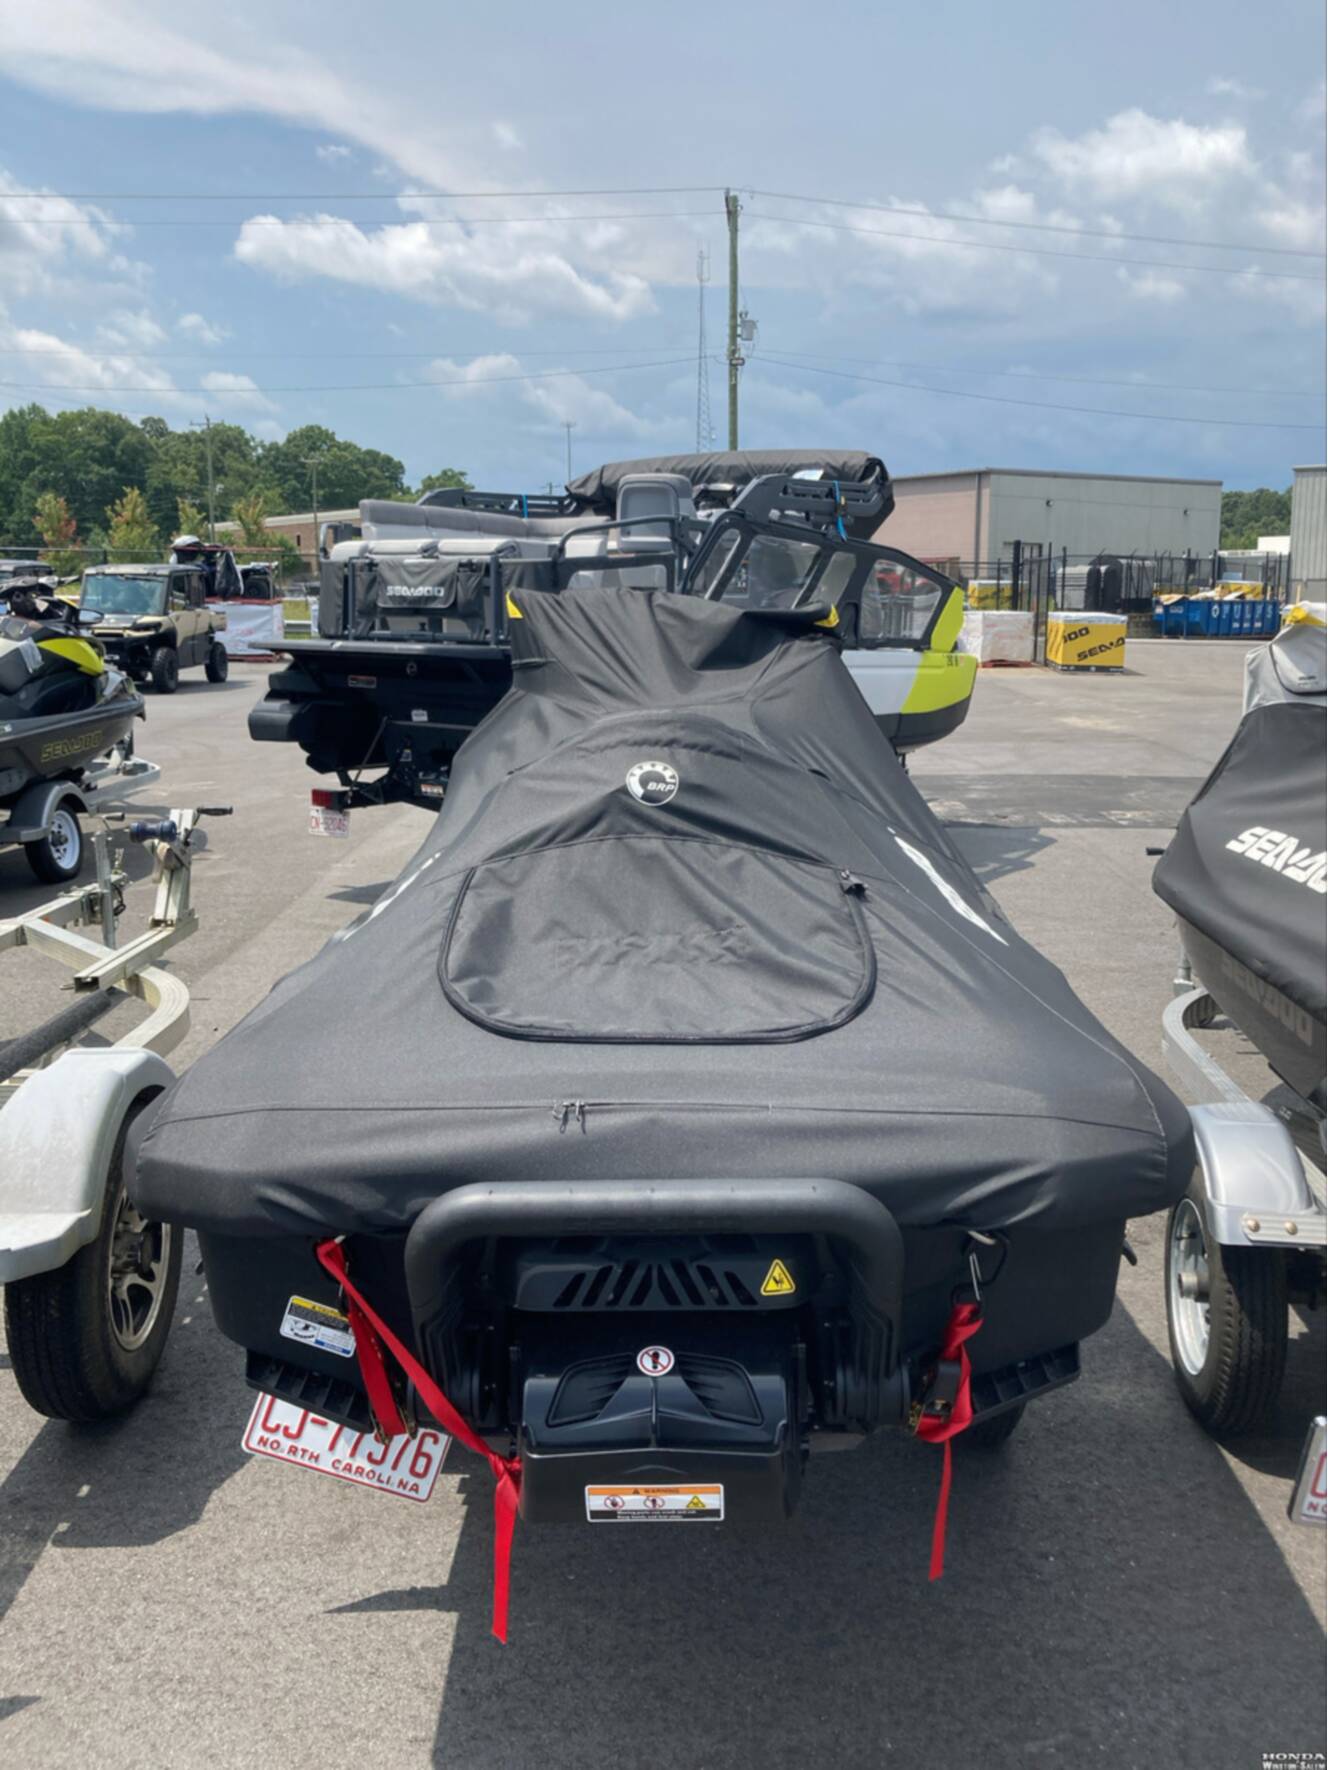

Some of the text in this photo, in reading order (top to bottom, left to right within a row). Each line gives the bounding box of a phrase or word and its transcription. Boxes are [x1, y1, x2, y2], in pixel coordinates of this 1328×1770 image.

[646, 781, 675, 792] BRP
[257, 1434, 421, 1495] NORTH CAROLINA
